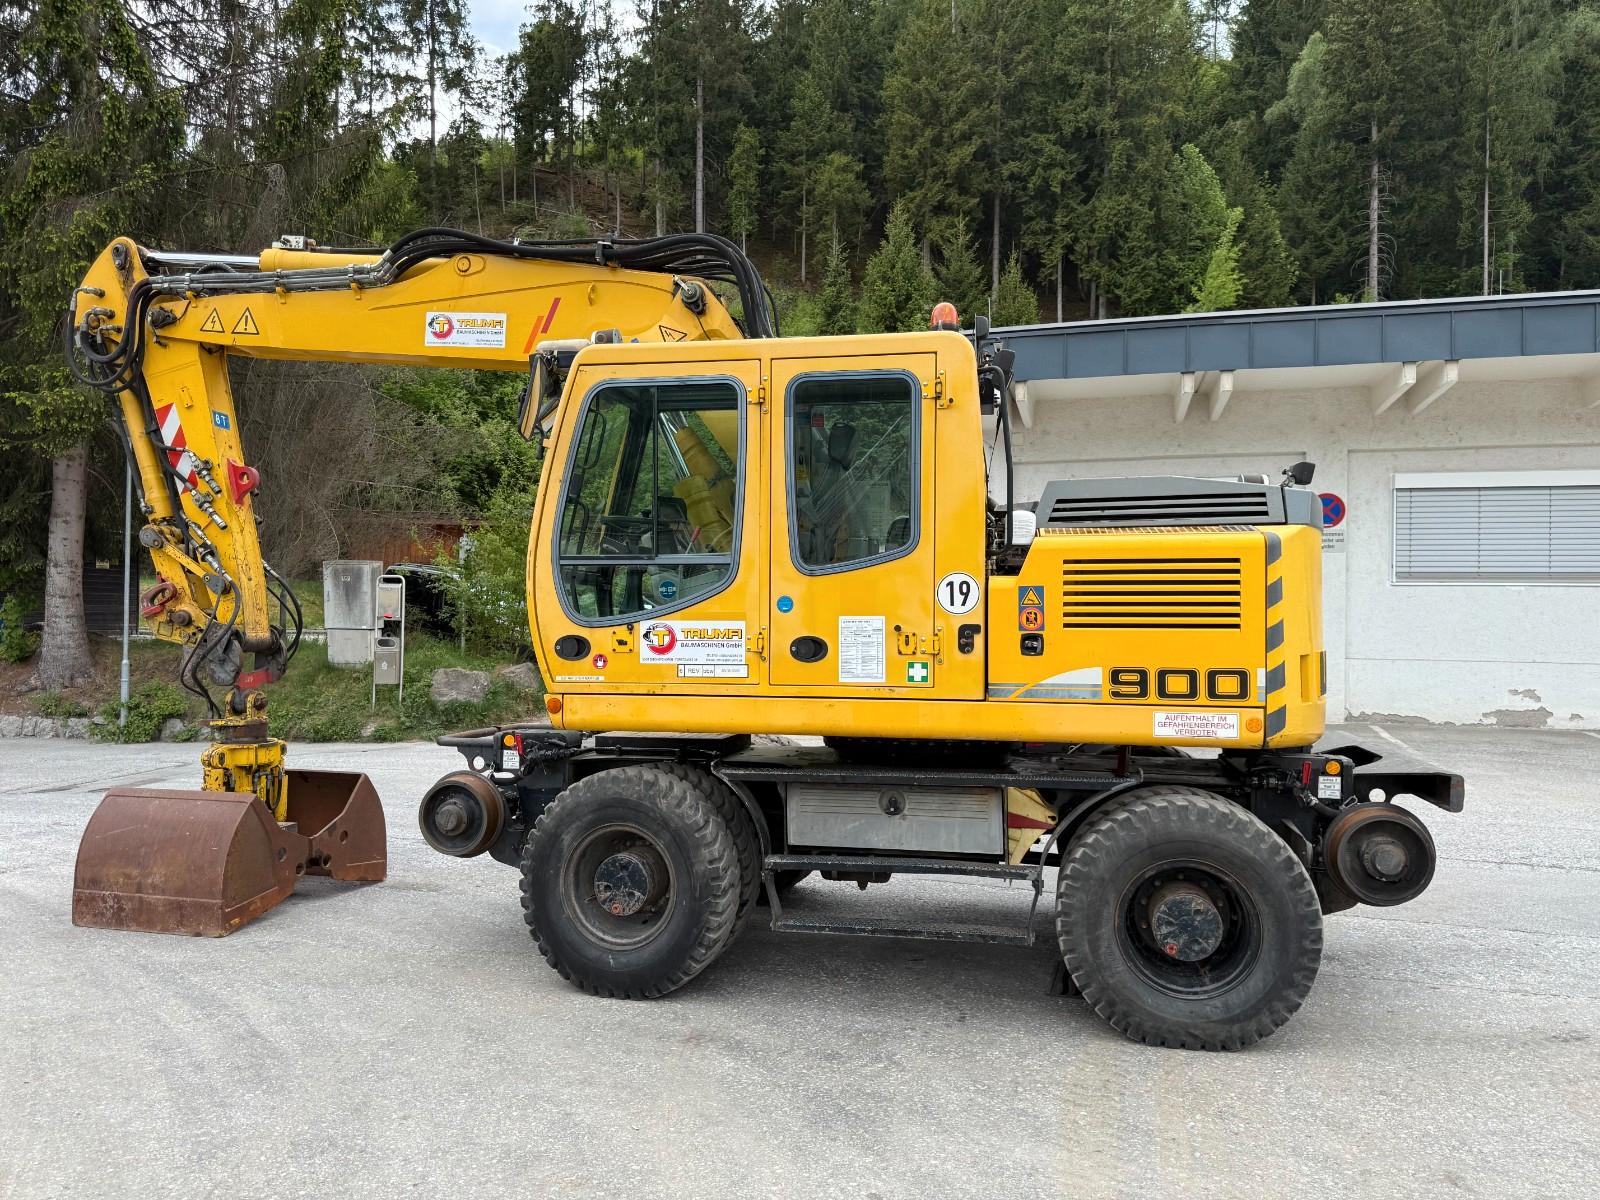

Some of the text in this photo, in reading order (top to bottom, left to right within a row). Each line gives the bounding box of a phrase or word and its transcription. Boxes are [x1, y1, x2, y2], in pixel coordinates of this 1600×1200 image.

[945, 580, 971, 607] 19
[681, 628, 742, 639] TRIUMFI
[680, 641, 743, 649] BAUMASCHINEN GmbH
[1108, 666, 1251, 702] 900
[1165, 714, 1217, 722] AUFENTHALT
[1158, 722, 1235, 730] GEFAHRENBEREICH
